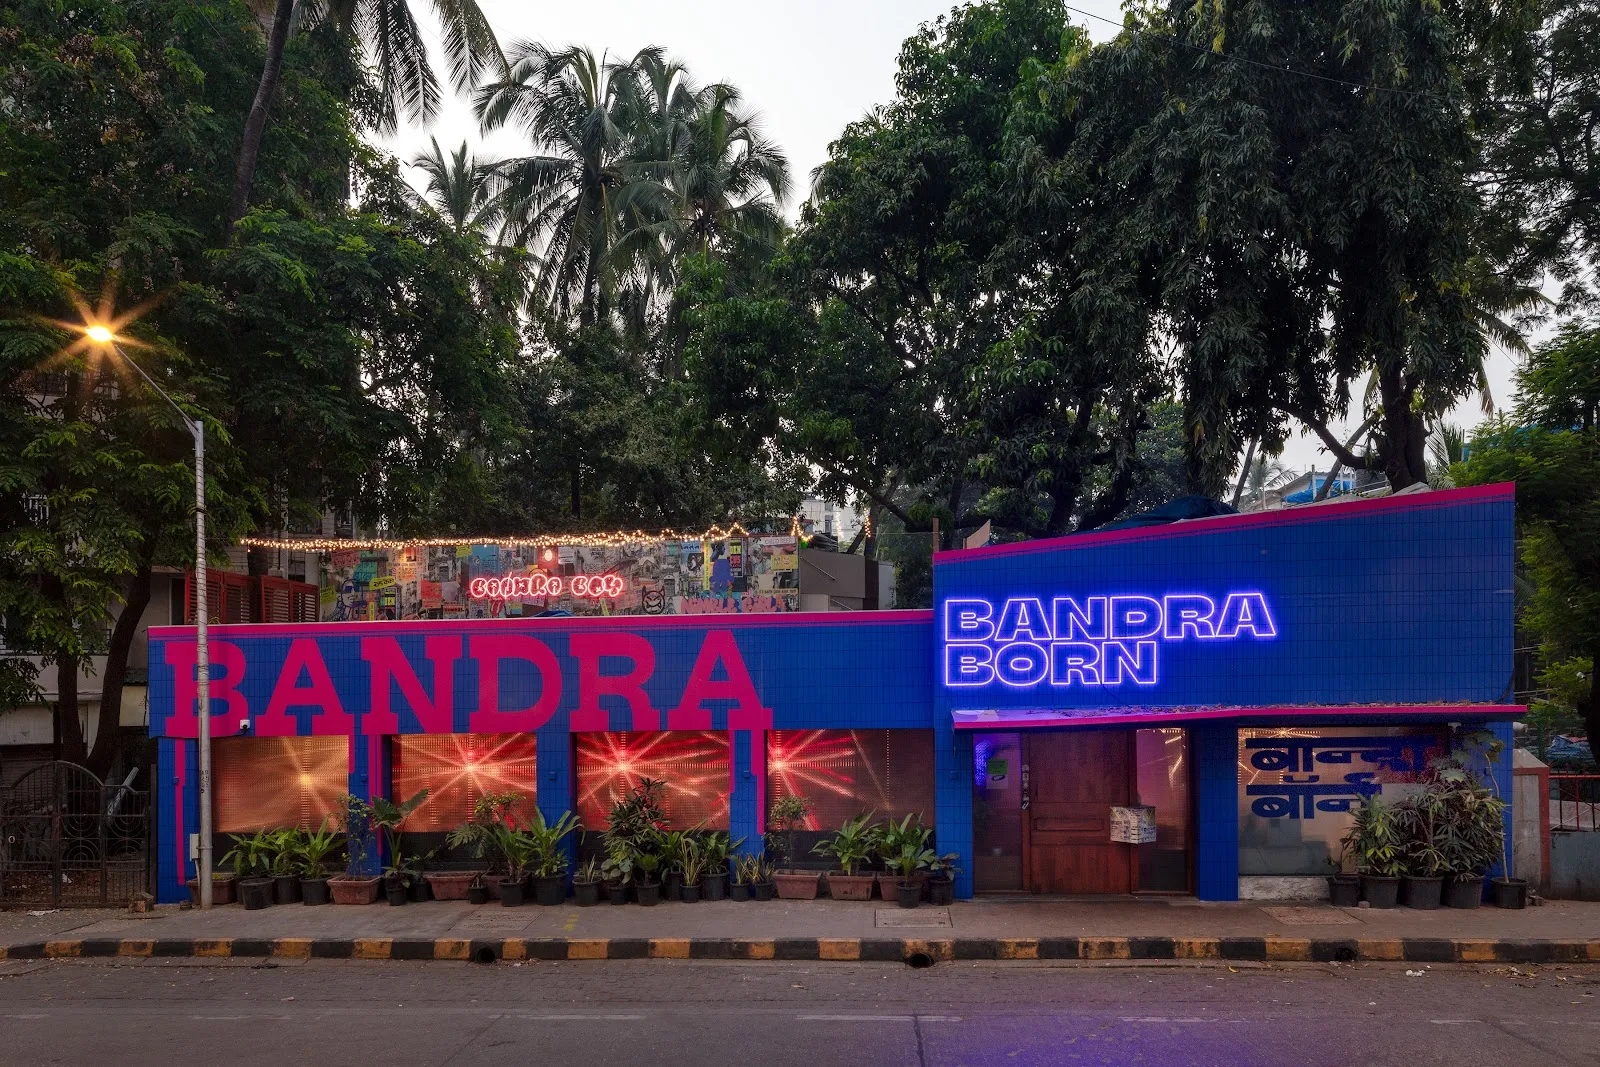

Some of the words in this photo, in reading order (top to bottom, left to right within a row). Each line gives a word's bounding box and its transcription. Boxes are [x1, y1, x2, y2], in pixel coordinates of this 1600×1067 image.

[943, 591, 1278, 643] BANDRA
[164, 629, 774, 738] BANDRA
[943, 640, 1159, 687] BORN
